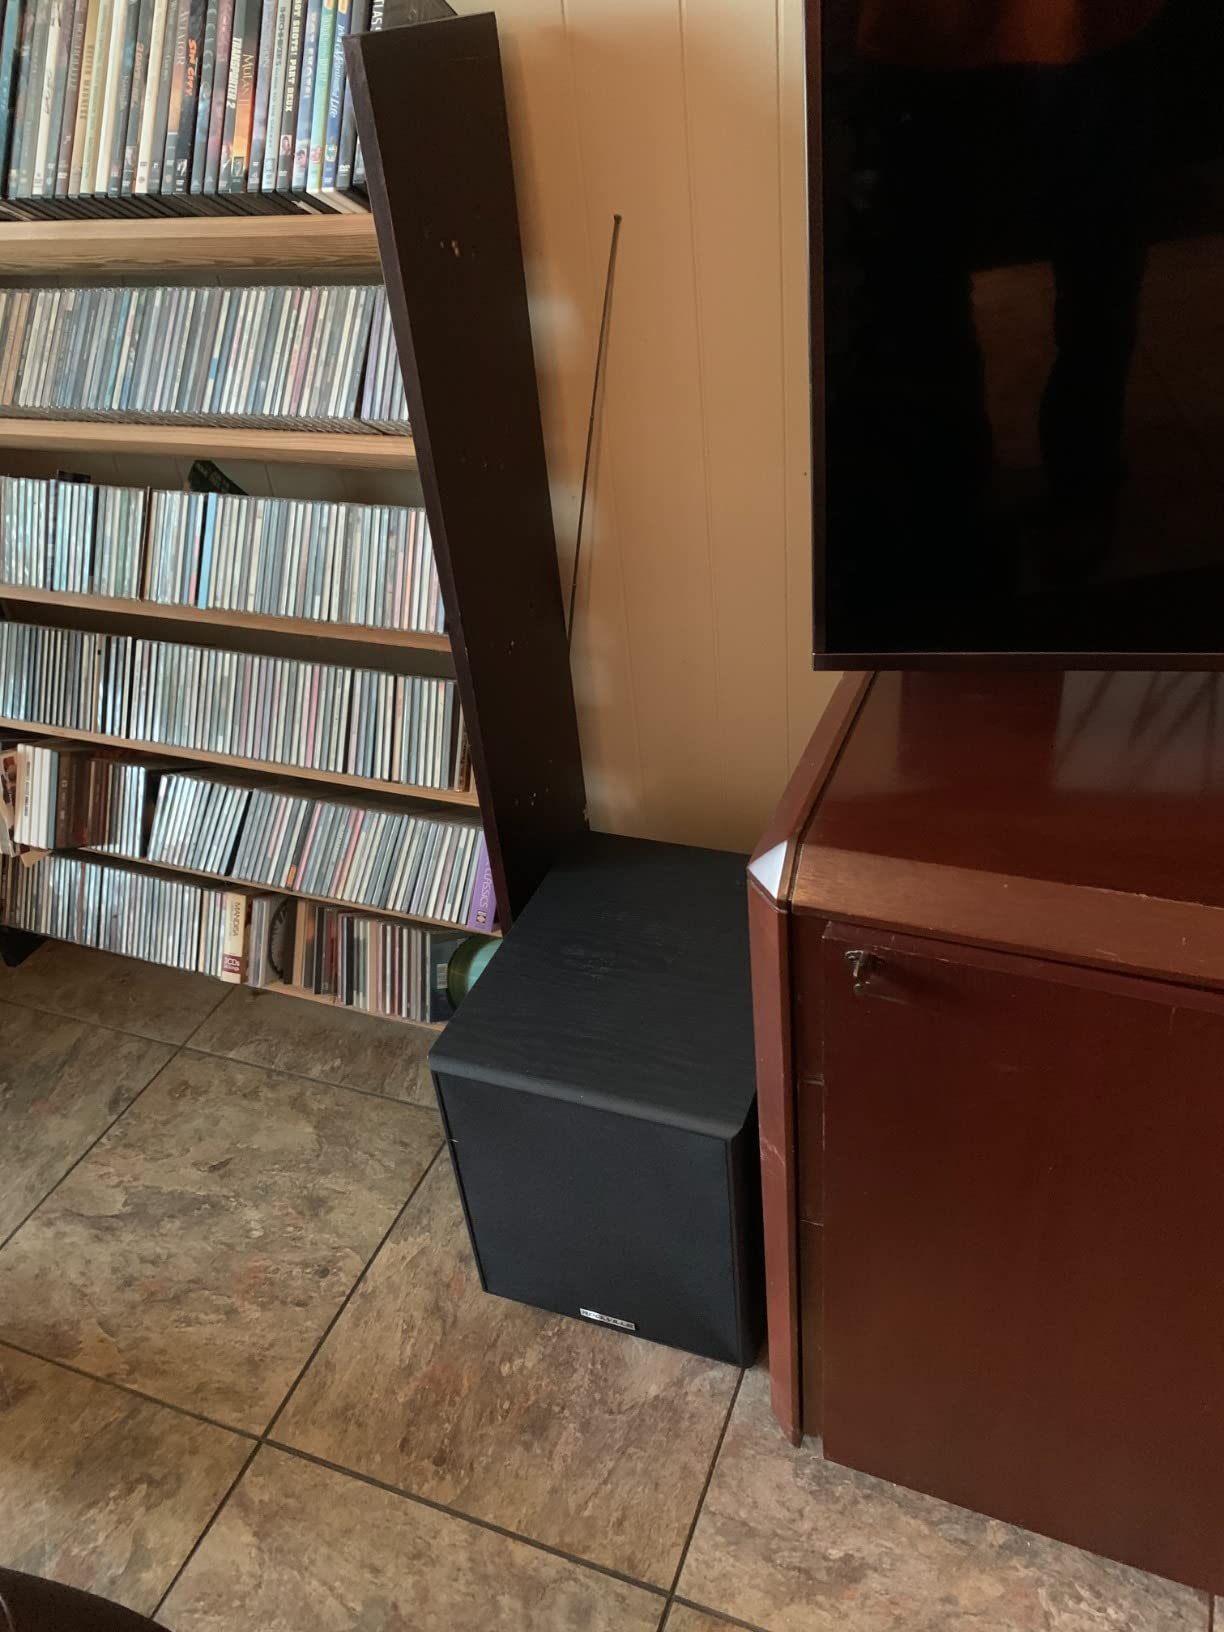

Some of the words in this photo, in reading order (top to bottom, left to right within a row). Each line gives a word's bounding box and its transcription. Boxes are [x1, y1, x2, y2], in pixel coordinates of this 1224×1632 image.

[175, 8, 189, 65] AVIATOR
[290, 20, 300, 55] SHOTS!
[187, 39, 197, 64] SIN
[185, 66, 195, 96] CITY
[228, 37, 242, 100] TRANSPORTER
[287, 59, 297, 85] PART
[226, 101, 236, 110] 2
[285, 87, 295, 112] DEUX
[329, 98, 340, 118] Life
[480, 867, 493, 908] CLASSICS
